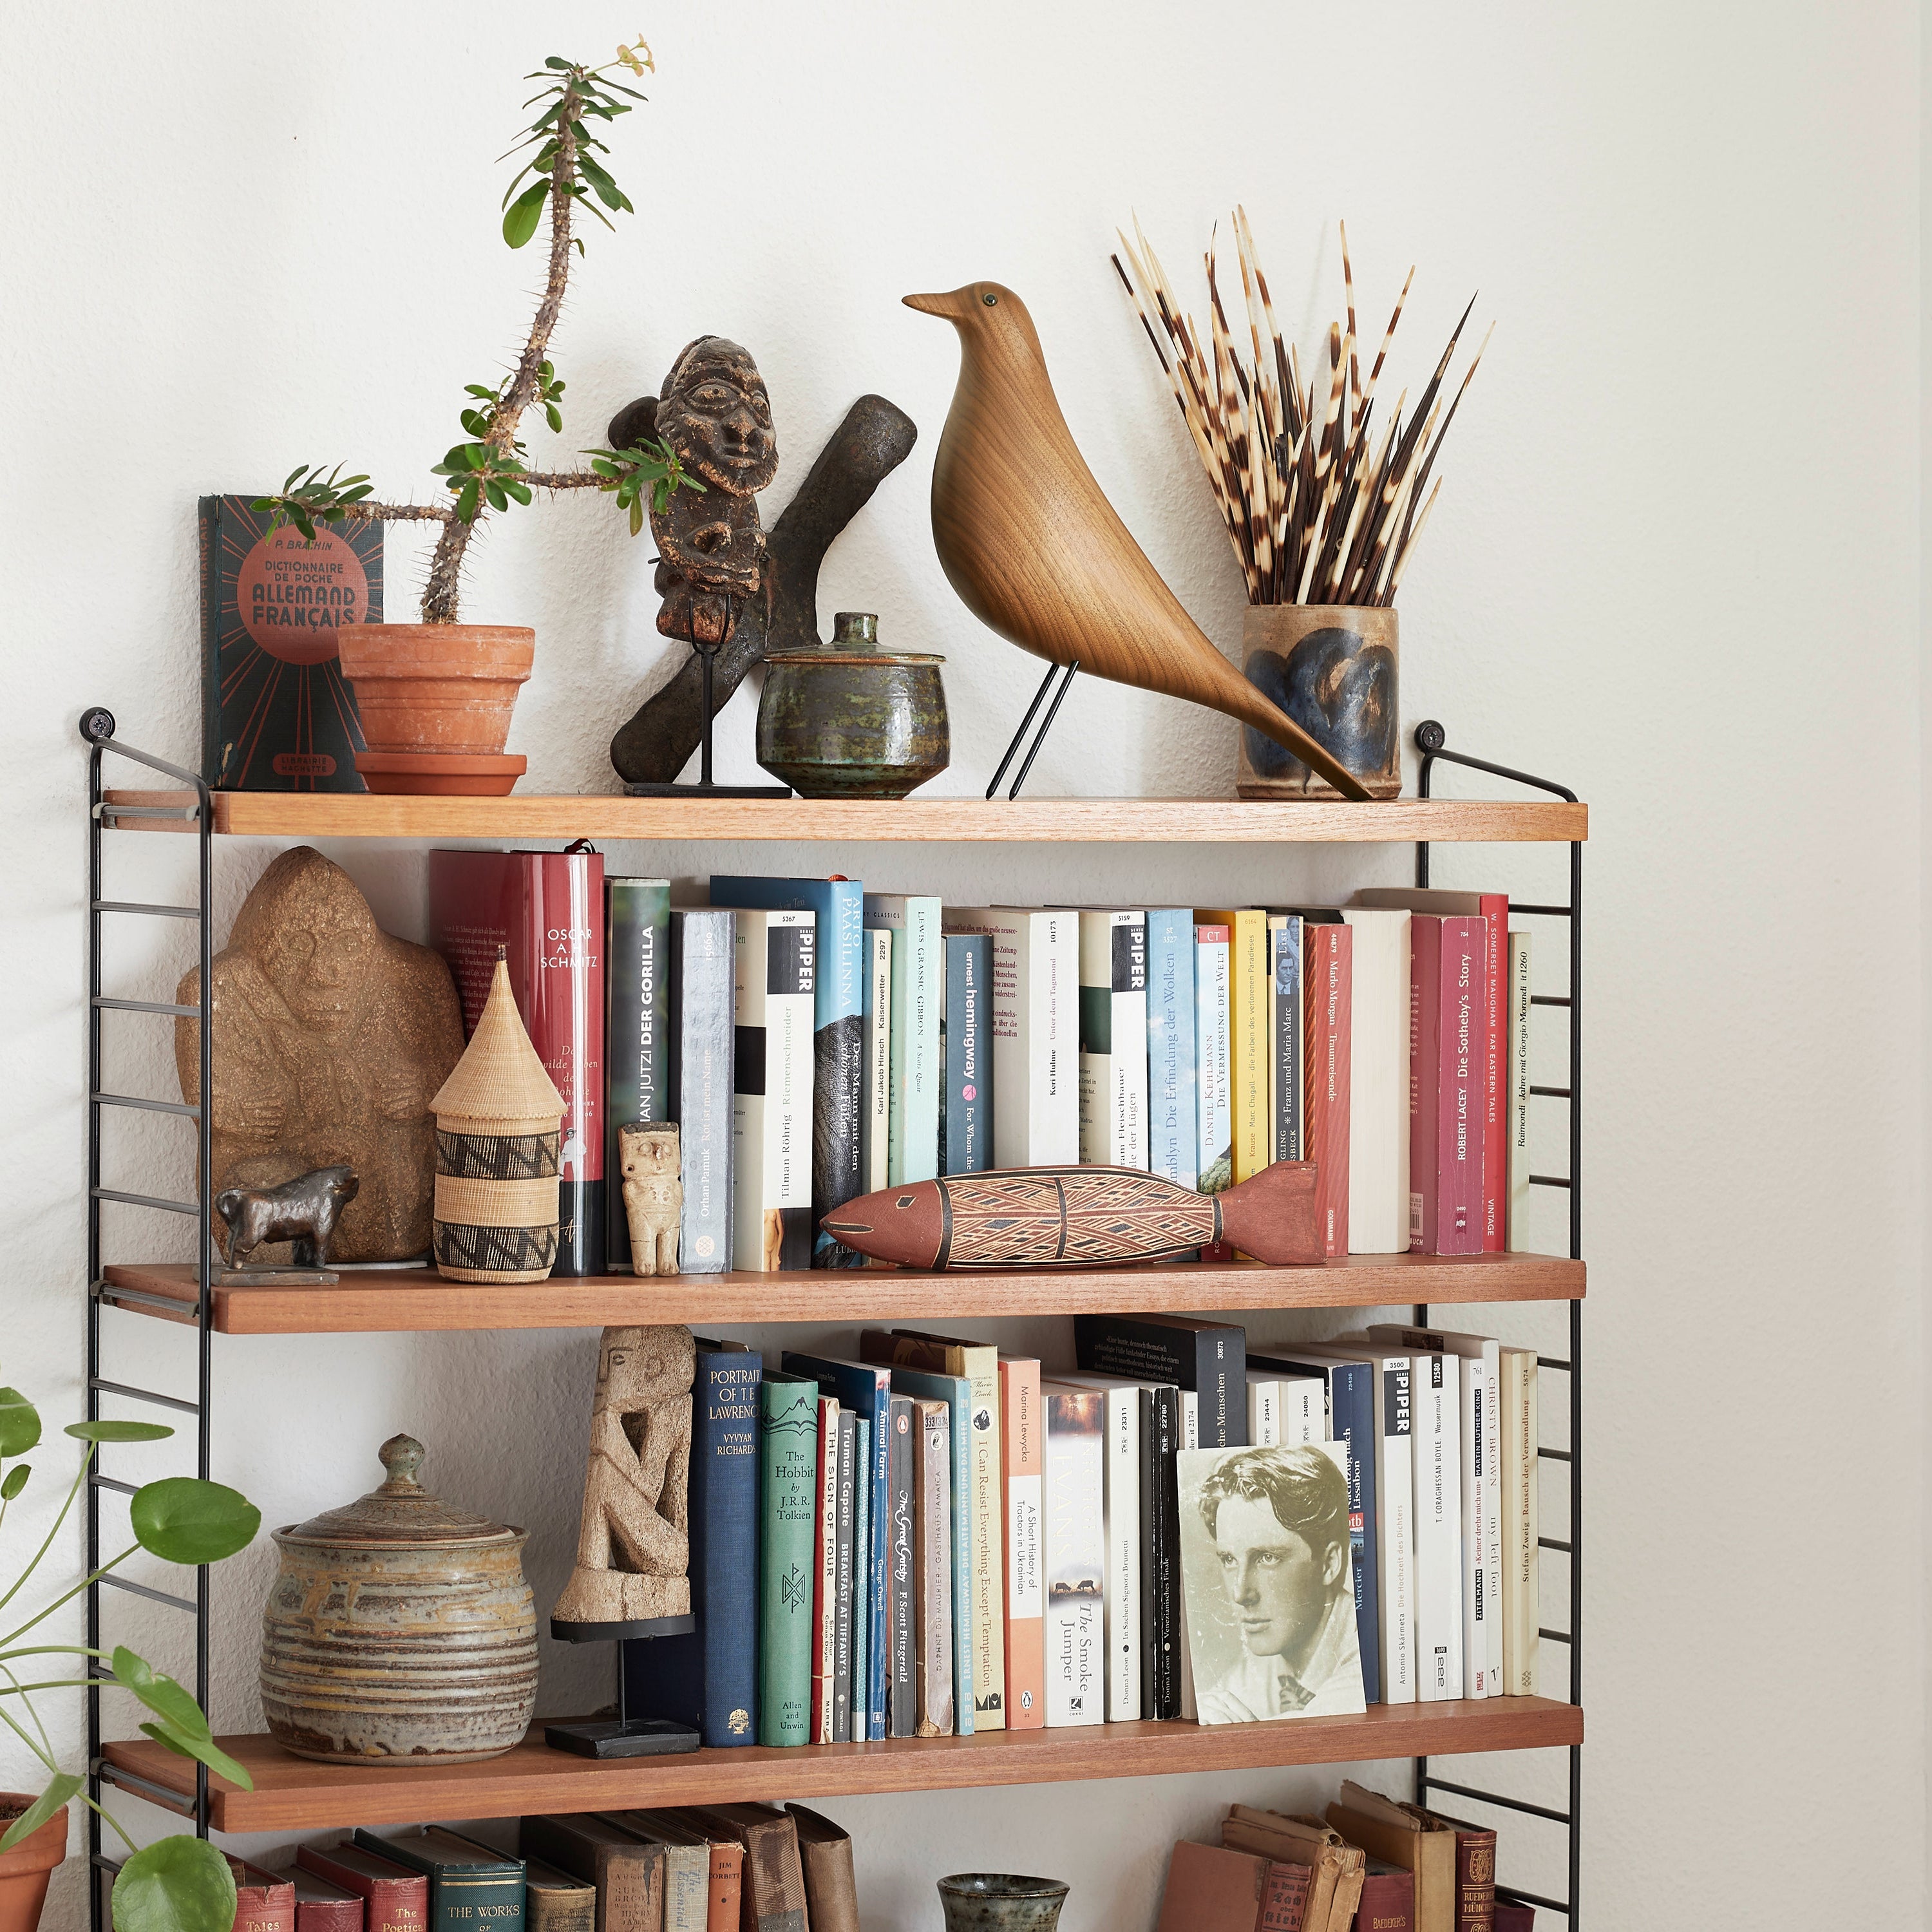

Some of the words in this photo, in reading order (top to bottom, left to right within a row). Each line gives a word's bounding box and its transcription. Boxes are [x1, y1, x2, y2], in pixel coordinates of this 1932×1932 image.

[275, 540, 285, 549] P.
[287, 540, 332, 551] BRACHIN
[265, 560, 343, 574] DICTIONNAIRE
[274, 574, 289, 582] DE
[295, 574, 333, 583] POCHE
[252, 583, 355, 607] ALLEMAND
[253, 607, 355, 632] FRANÇAIS
[281, 757, 327, 766] LIBRAIRIE
[547, 929, 592, 940] OSCAR
[853, 896, 861, 947] ARTO
[1207, 931, 1220, 942] CT
[842, 898, 853, 1007] PAASILINNA
[1279, 932, 1287, 954] List
[540, 956, 598, 968] SCHMITZ
[641, 925, 653, 1005] GORILLA
[799, 934, 813, 991] PIPER
[965, 951, 974, 986] ernest
[1130, 933, 1144, 989] PIPER
[1329, 961, 1338, 988] Marlo
[1459, 954, 1472, 987] Story
[1163, 952, 1175, 1004] Wolken
[1164, 1008, 1175, 1030] der
[1282, 1007, 1291, 1032] Marc
[1328, 990, 1338, 1025] Morgan
[641, 1009, 652, 1045] DER
[963, 989, 978, 1079] hemingway
[1458, 994, 1471, 1054] Sotheby's
[782, 1006, 791, 1105] Riemenschneider
[1217, 1010, 1226, 1083] VERMESSUNG
[1283, 1035, 1291, 1063] Maria
[1519, 1025, 1528, 1057] Giorgio
[703, 1050, 712, 1080] Name
[840, 1041, 851, 1091] schönen
[1164, 1034, 1178, 1100] Erfindung
[1204, 1035, 1213, 1099] KEHLMANN
[1283, 1065, 1291, 1084] und
[1328, 1033, 1338, 1102] Traumreisende
[1457, 1057, 1468, 1077] Die
[852, 1072, 860, 1113] Mann
[1283, 1086, 1292, 1113] Franz
[1458, 1088, 1466, 1119] LACEY
[1128, 1093, 1138, 1126] Lügen
[1166, 1105, 1177, 1128] Die
[1205, 1103, 1214, 1146] DANIEL
[781, 1114, 792, 1153] Röhrig
[1458, 1122, 1466, 1160] ROBERT
[701, 1149, 710, 1183] Pamuk
[852, 1145, 860, 1171] den
[781, 1159, 790, 1199] Tilman
[701, 1186, 710, 1217] Orhan
[710, 1370, 760, 1383] PORTRAIT
[1432, 1363, 1441, 1383] 12580
[1473, 1367, 1482, 1376] 761
[719, 1388, 736, 1401] OF
[1021, 1386, 1029, 1420] Marina
[1217, 1373, 1226, 1426] Menschen
[1396, 1376, 1410, 1432] PIPER
[717, 1445, 755, 1455] RICHARDS
[723, 1433, 752, 1443] VYVYAN
[843, 1428, 852, 1476] Truman
[1019, 1423, 1030, 1462] Lewycka
[786, 1451, 804, 1461] The
[979, 1449, 989, 1472] Can
[775, 1466, 814, 1478] Hobbit
[840, 1481, 851, 1526] Capote
[979, 1475, 989, 1509] Resist
[777, 1510, 810, 1520] Tolkien
[827, 1511, 833, 1529] OF
[1017, 1500, 1025, 1537] Tractors
[1028, 1517, 1036, 1540] Short
[1488, 1517, 1497, 1537] my
[978, 1513, 990, 1575] Everything
[840, 1544, 848, 1602] BREAKFAST
[1027, 1544, 1036, 1576] History
[979, 1578, 990, 1617] Except
[1354, 1567, 1363, 1610] Mercier
[1491, 1571, 1499, 1597] foot
[840, 1606, 848, 1619] AT
[899, 1601, 907, 1627] Scott
[1079, 1603, 1092, 1633] The
[897, 1630, 907, 1683] Fitzgerald
[980, 1620, 992, 1687] Temptation
[1060, 1620, 1075, 1681] Jumper
[1079, 1638, 1093, 1692] Smoke
[247, 1921, 279, 1931] Tales
[395, 1908, 417, 1918] The
[448, 1907, 473, 1918] THE
[478, 1905, 520, 1917] WORKS
[1373, 1915, 1406, 1929] BAEDEKER'S
